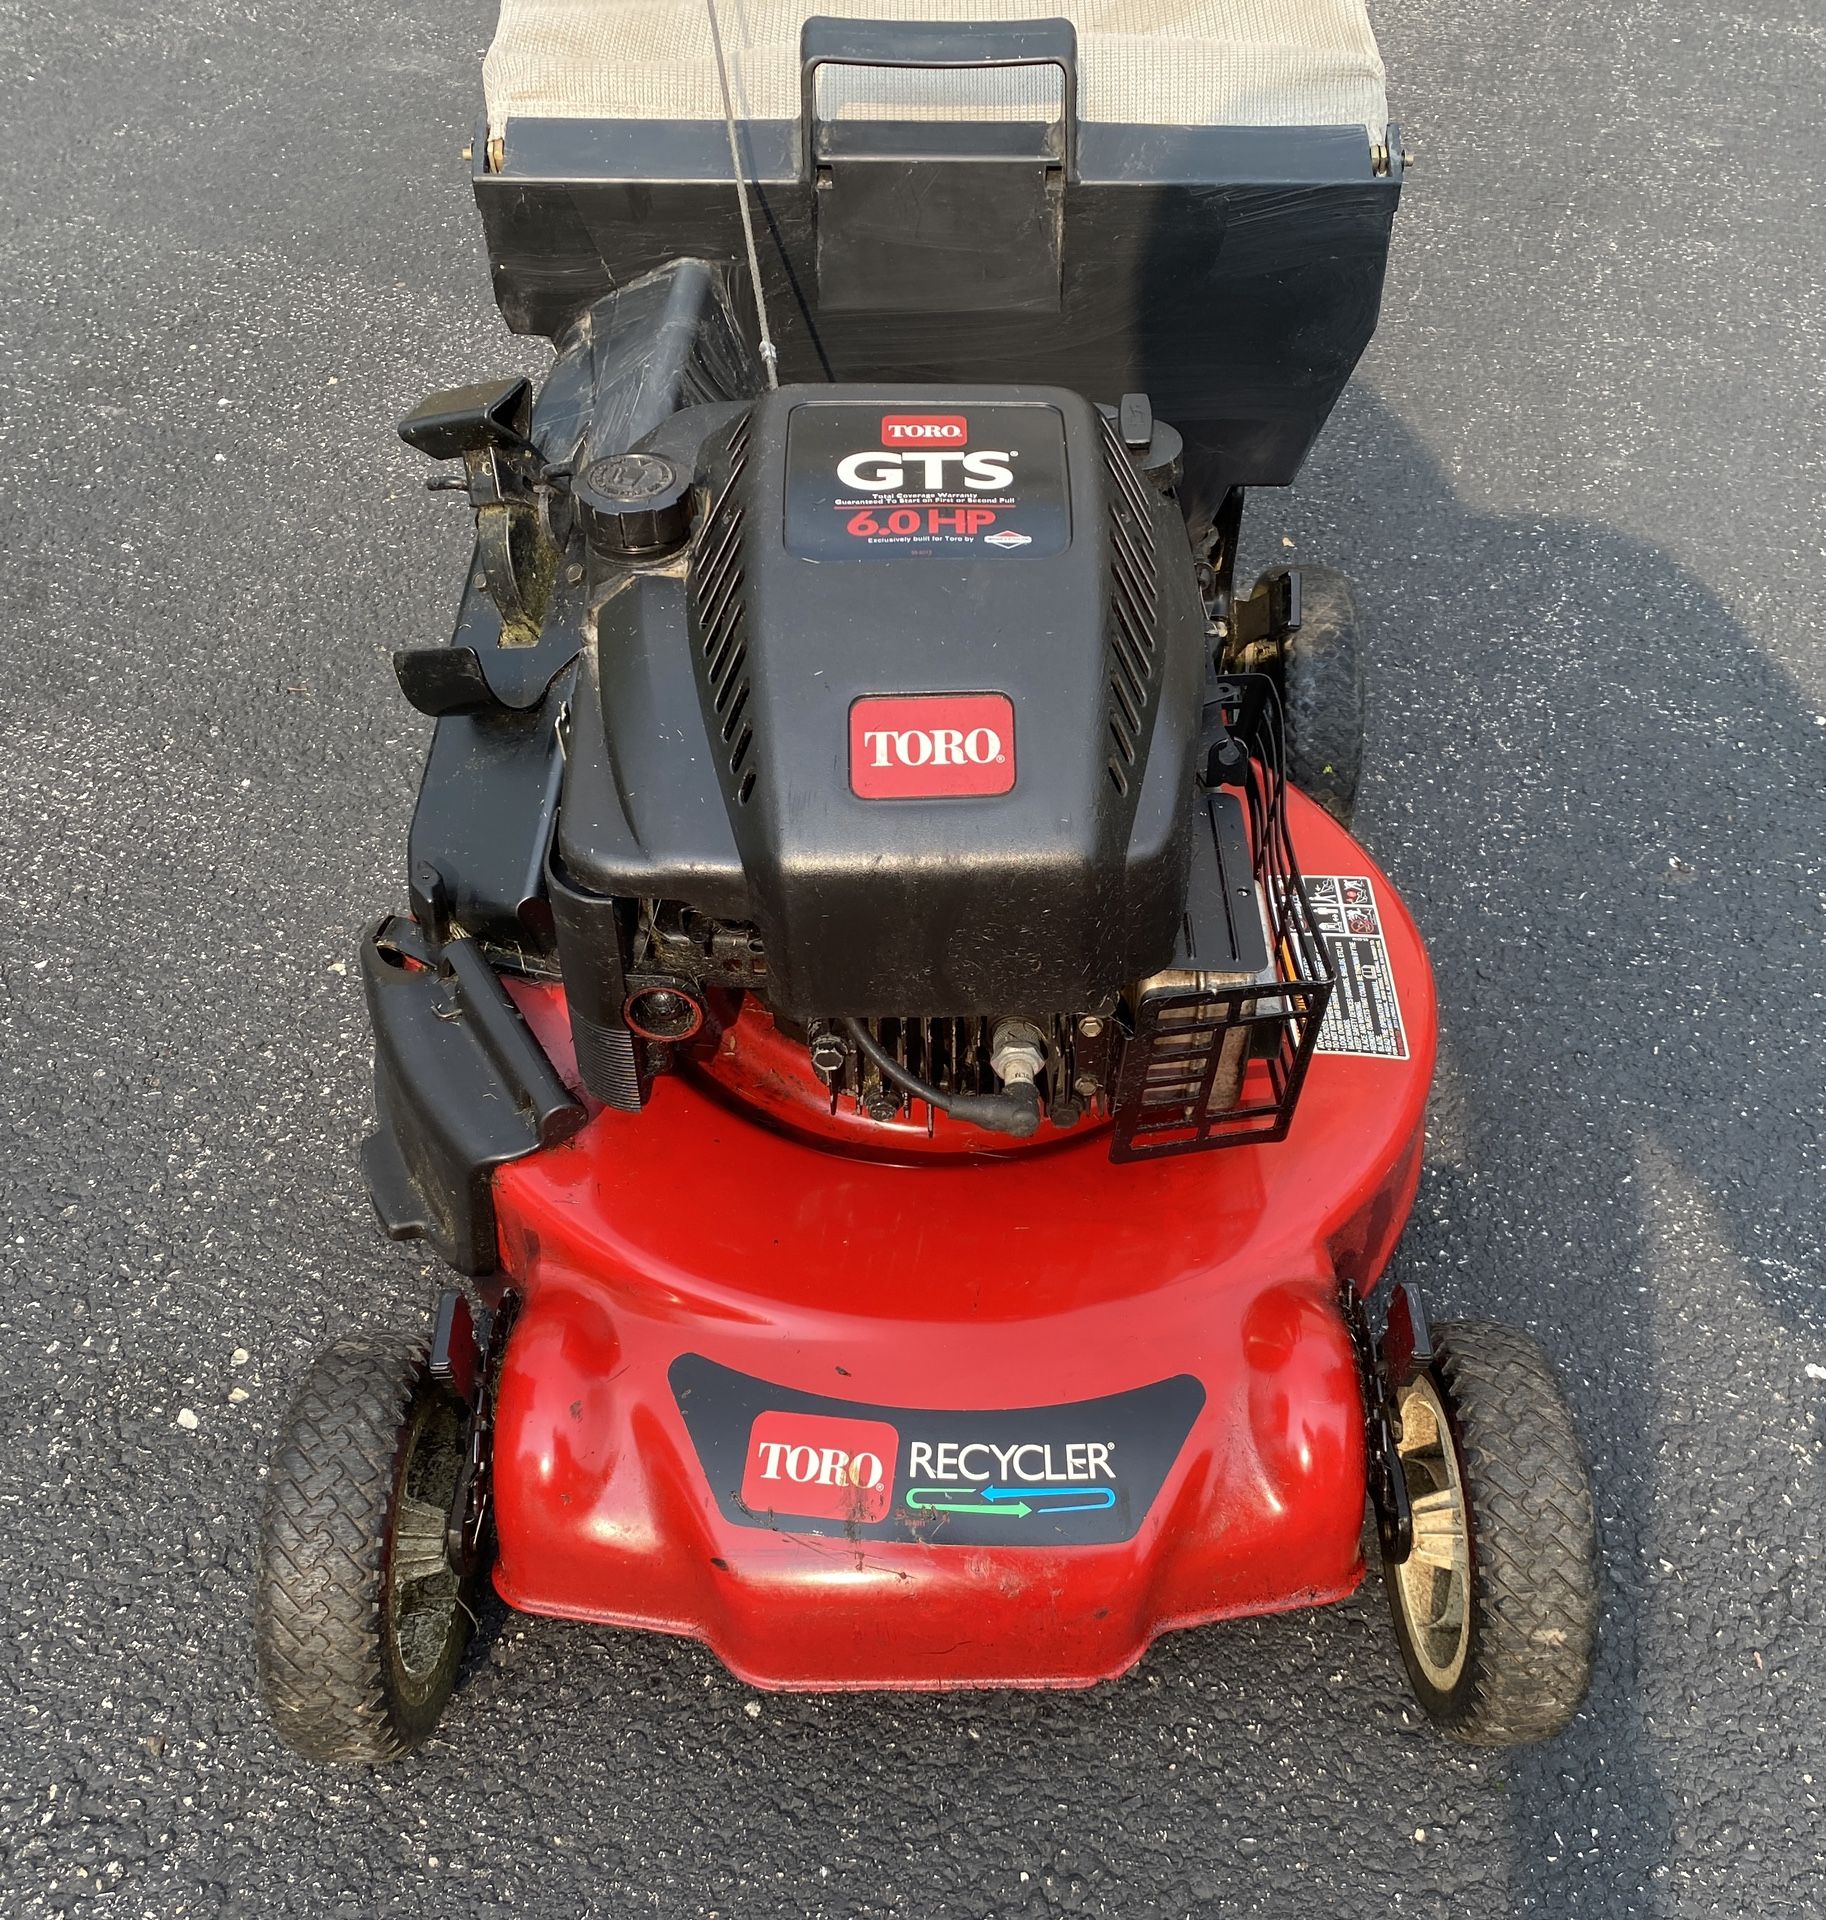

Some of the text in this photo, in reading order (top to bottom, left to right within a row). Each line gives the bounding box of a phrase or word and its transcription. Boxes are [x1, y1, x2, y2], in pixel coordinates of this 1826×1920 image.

[837, 451, 1014, 490] GTS
[847, 509, 996, 536] 6.0 HP
[1350, 1018, 1359, 1035] SAFETY
